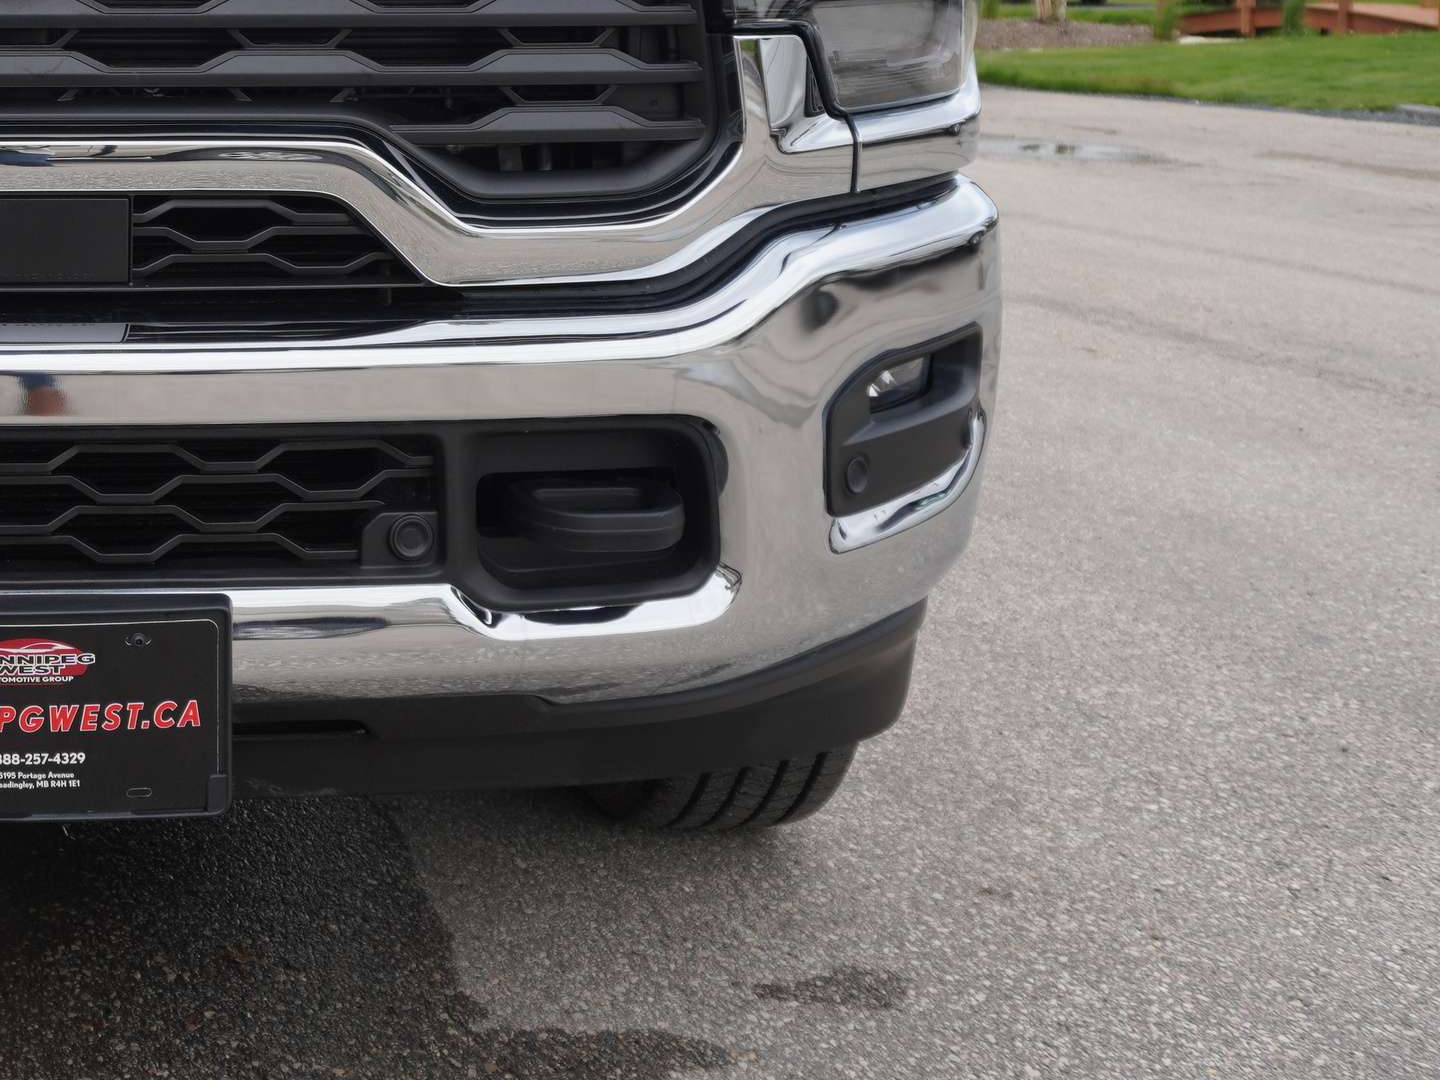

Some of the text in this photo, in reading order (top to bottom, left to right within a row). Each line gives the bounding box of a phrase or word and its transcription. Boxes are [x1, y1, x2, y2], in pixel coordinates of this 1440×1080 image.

[18, 772, 47, 781] Portage
[48, 771, 75, 779] Avenue
[50, 780, 67, 788] R4H
